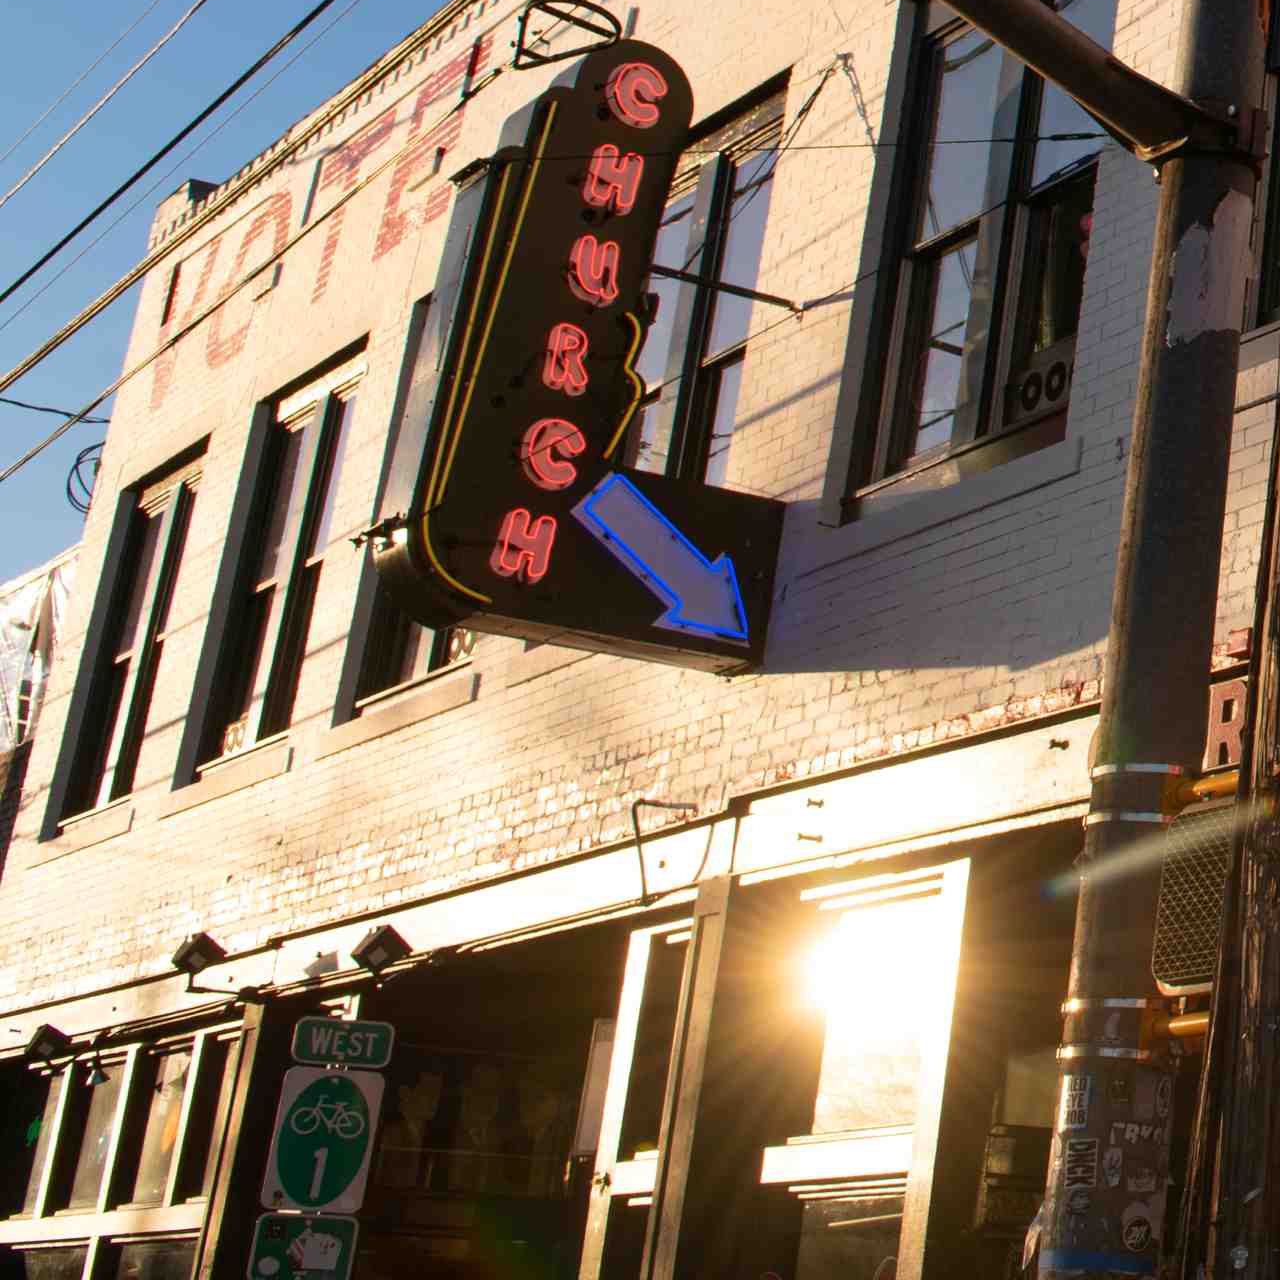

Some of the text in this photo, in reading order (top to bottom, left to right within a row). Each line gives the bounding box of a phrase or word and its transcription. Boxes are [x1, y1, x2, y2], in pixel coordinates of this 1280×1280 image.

[490, 62, 669, 585] CHURCH
[1203, 678, 1246, 770] R
[311, 1026, 380, 1058] WEST
[309, 1146, 329, 1200] 1
